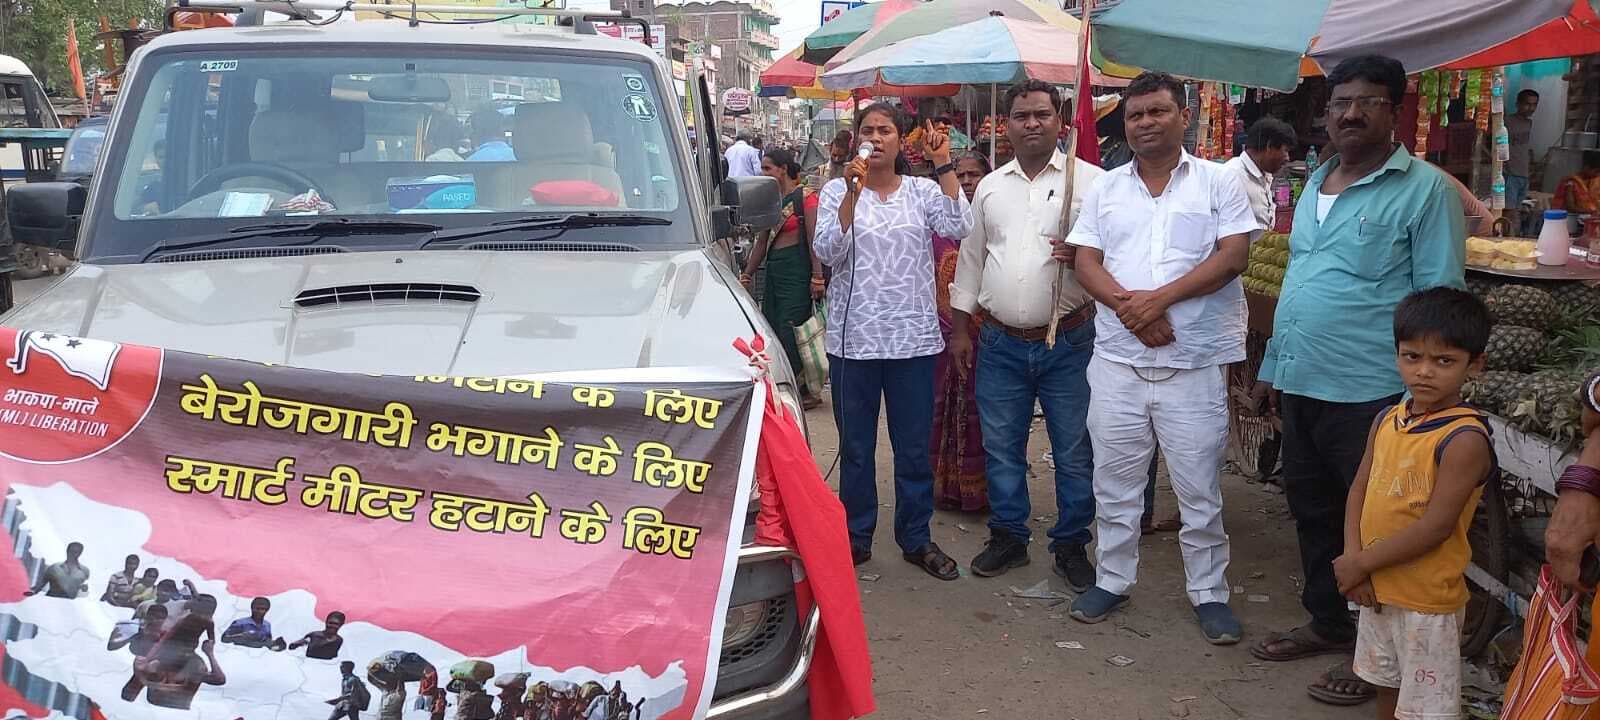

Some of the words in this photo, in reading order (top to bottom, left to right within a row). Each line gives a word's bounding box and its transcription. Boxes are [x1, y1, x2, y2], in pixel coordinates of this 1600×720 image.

[4, 388, 99, 416] भाकपा-माले
[643, 388, 723, 429] लिए
[29, 413, 109, 437] LIBERATION
[179, 374, 418, 449] बेरोजगारी
[426, 423, 564, 470] भगाने
[572, 435, 623, 476] के
[633, 441, 712, 493] लिए
[165, 455, 296, 505] स्मार्ट
[301, 464, 424, 521] मीटर
[429, 492, 551, 538] हटाने
[559, 501, 612, 544] के
[622, 506, 702, 559] लिए
[1415, 668, 1437, 686] 05
